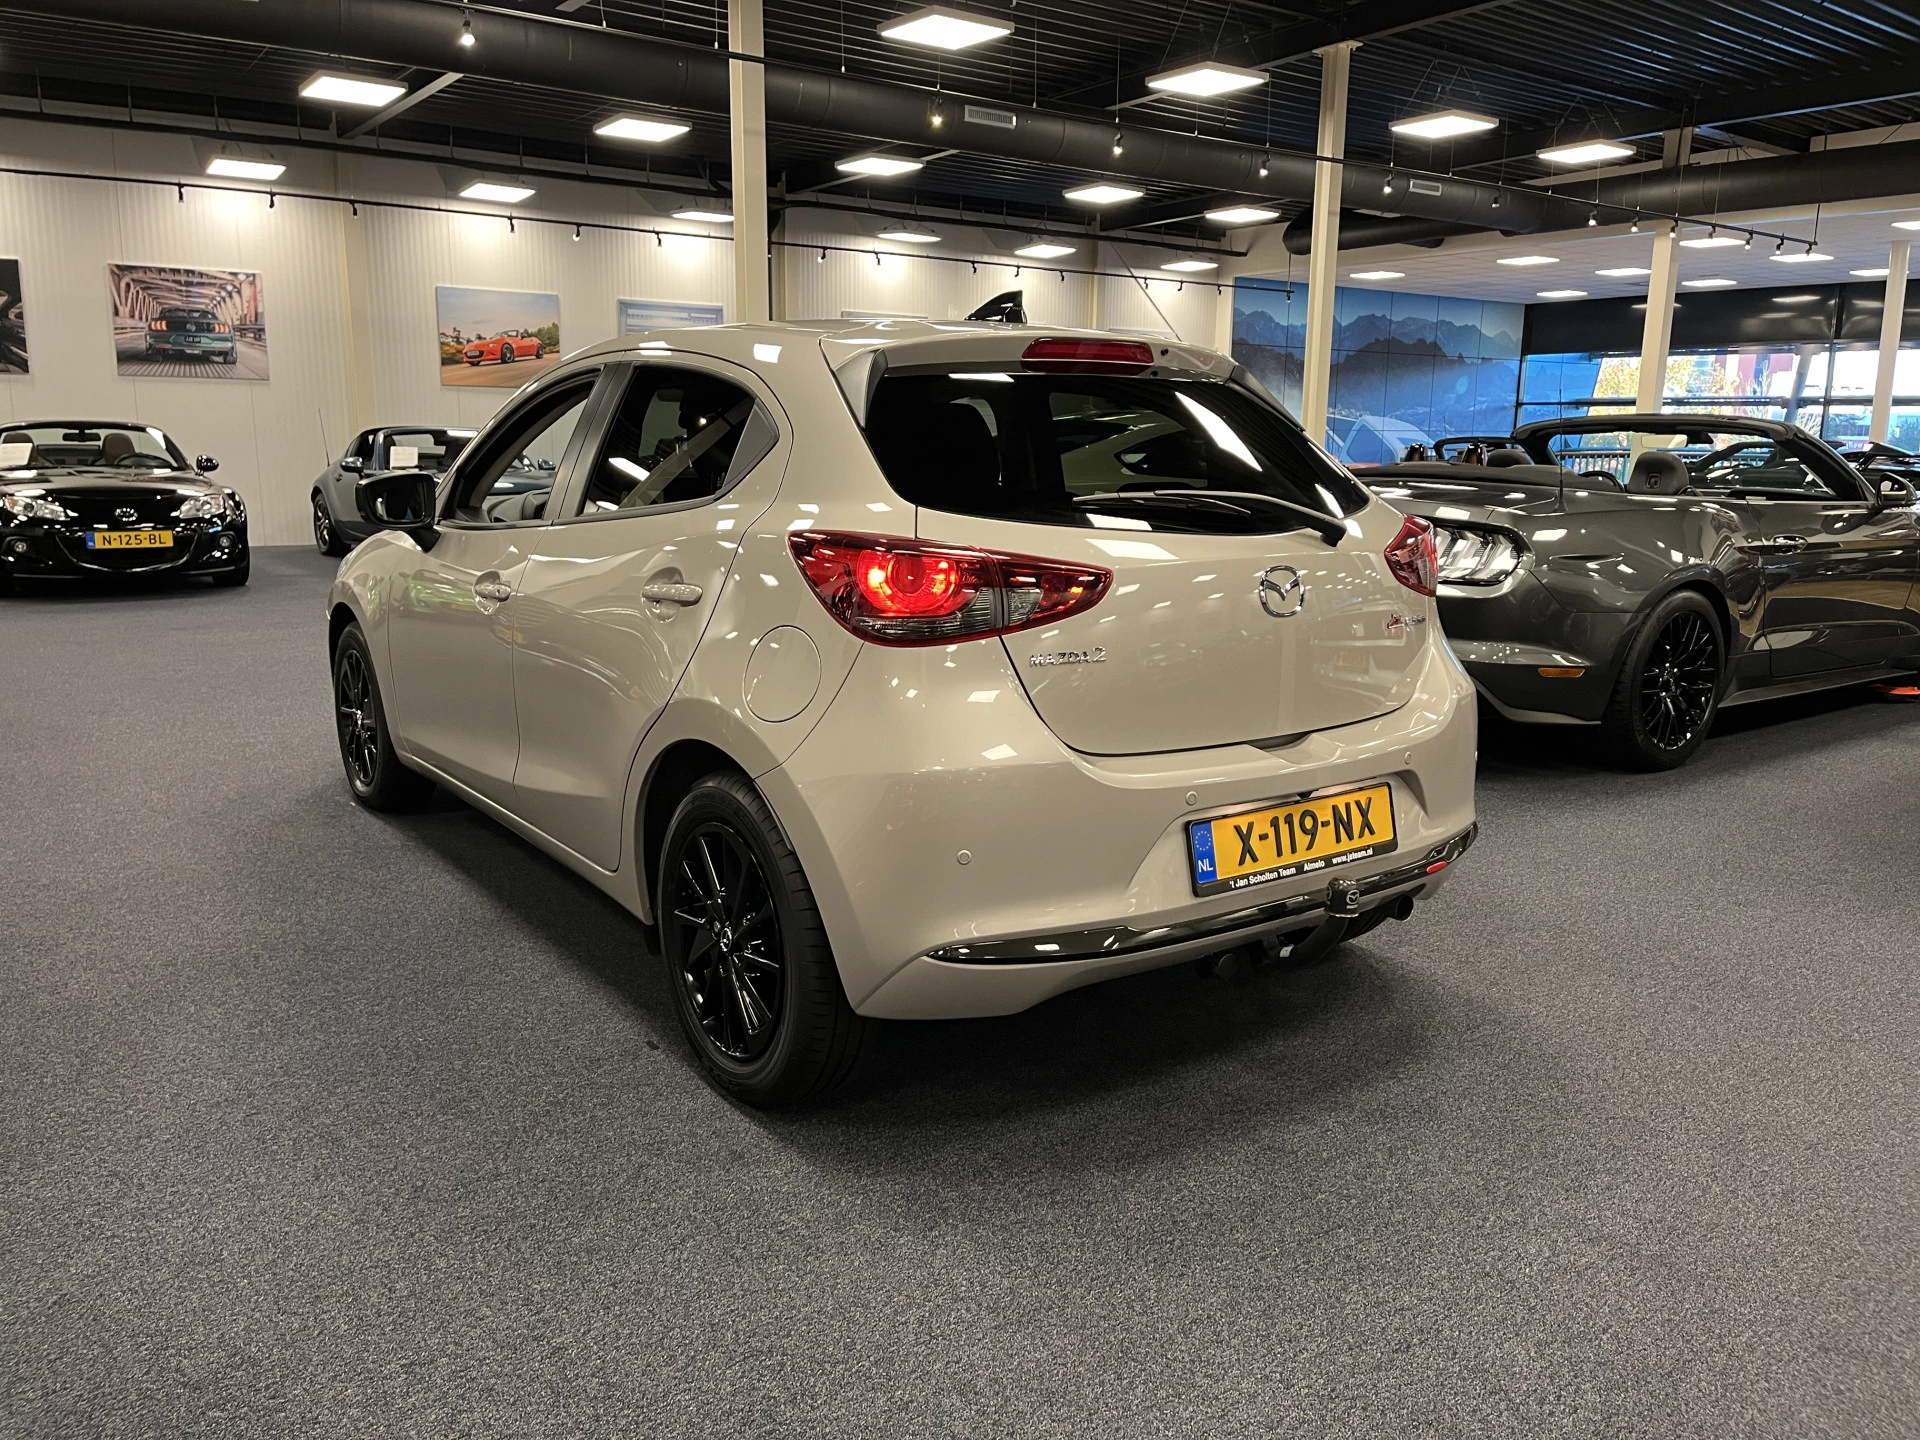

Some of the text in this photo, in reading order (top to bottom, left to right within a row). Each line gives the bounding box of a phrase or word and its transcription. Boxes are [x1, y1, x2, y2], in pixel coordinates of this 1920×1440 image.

[102, 534, 166, 546] N-125-BL
[1233, 797, 1376, 867] X-119-NX
[1198, 859, 1214, 873] NL
[1235, 878, 1249, 888] Jan
[1248, 871, 1279, 885] Scholten
[1279, 867, 1297, 878] Team
[1303, 860, 1325, 872] Almelo
[1332, 847, 1374, 865] www.jsteam.nl
